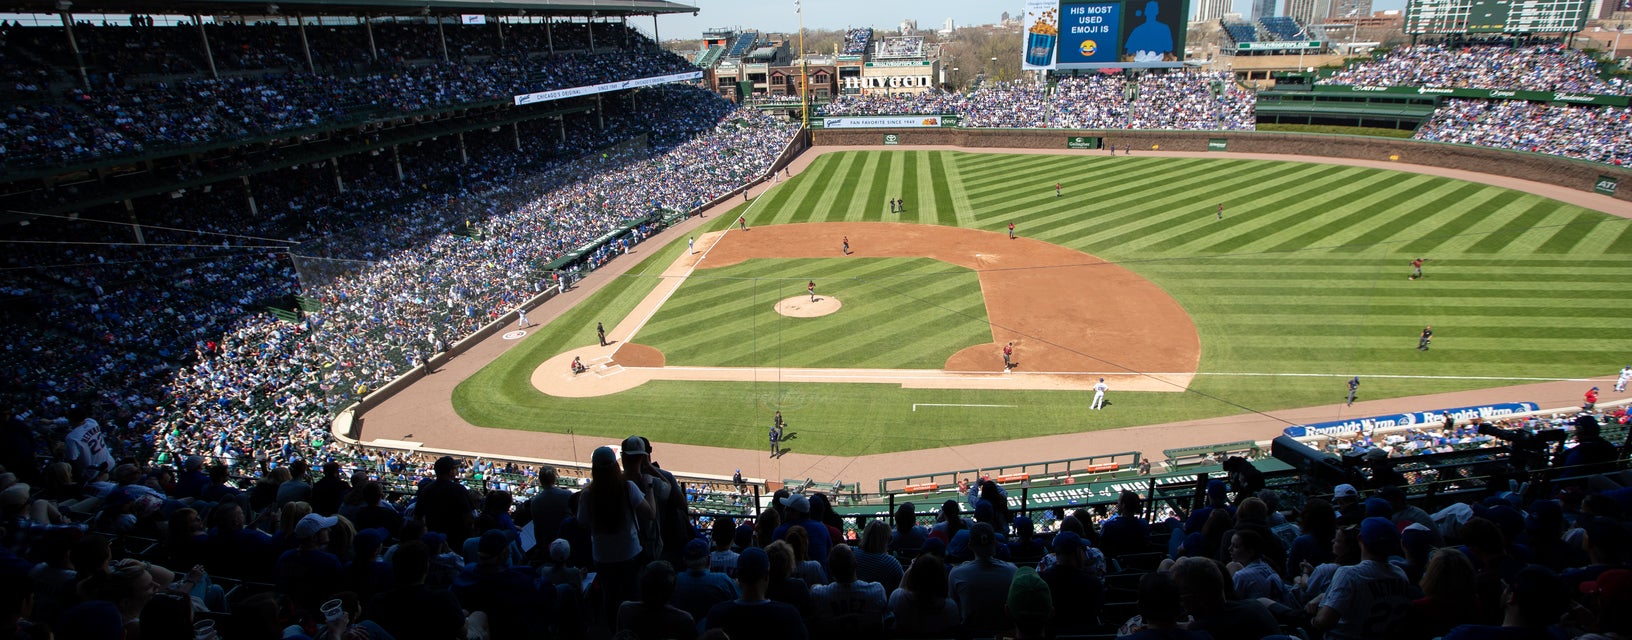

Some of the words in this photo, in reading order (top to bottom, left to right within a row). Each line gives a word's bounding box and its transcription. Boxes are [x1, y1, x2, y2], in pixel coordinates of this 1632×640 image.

[1087, 6, 1113, 14] MOST
[1079, 16, 1103, 24] USED
[1071, 26, 1098, 34] EMOJI
[1100, 25, 1109, 33] IS
[845, 76, 931, 89] nuveen
[1597, 181, 1617, 189] ATI
[1032, 487, 1095, 504] CONFINES
